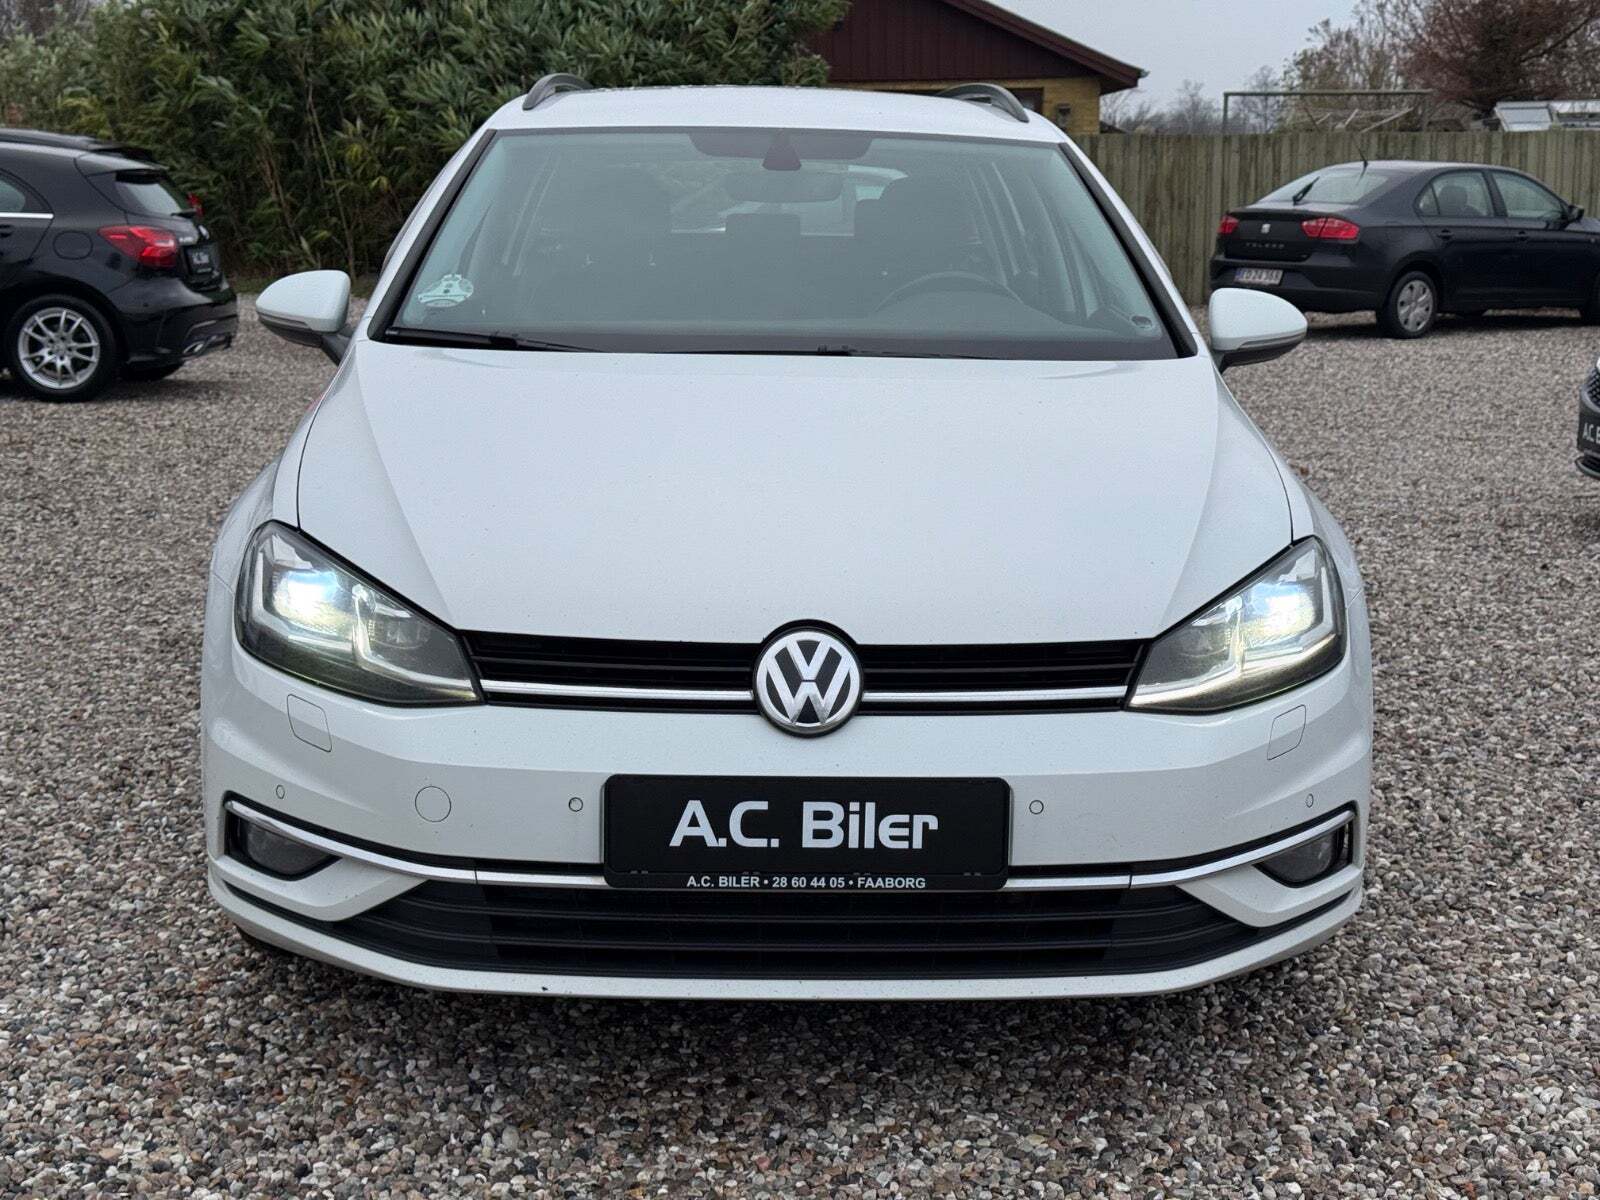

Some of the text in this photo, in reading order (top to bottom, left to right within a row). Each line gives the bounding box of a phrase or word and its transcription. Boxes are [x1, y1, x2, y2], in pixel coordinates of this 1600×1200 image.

[756, 630, 861, 729] VW
[669, 799, 939, 849] A.C. Biler
[686, 875, 926, 889] A.C. BILER 28 60 44 05 FAABORG
